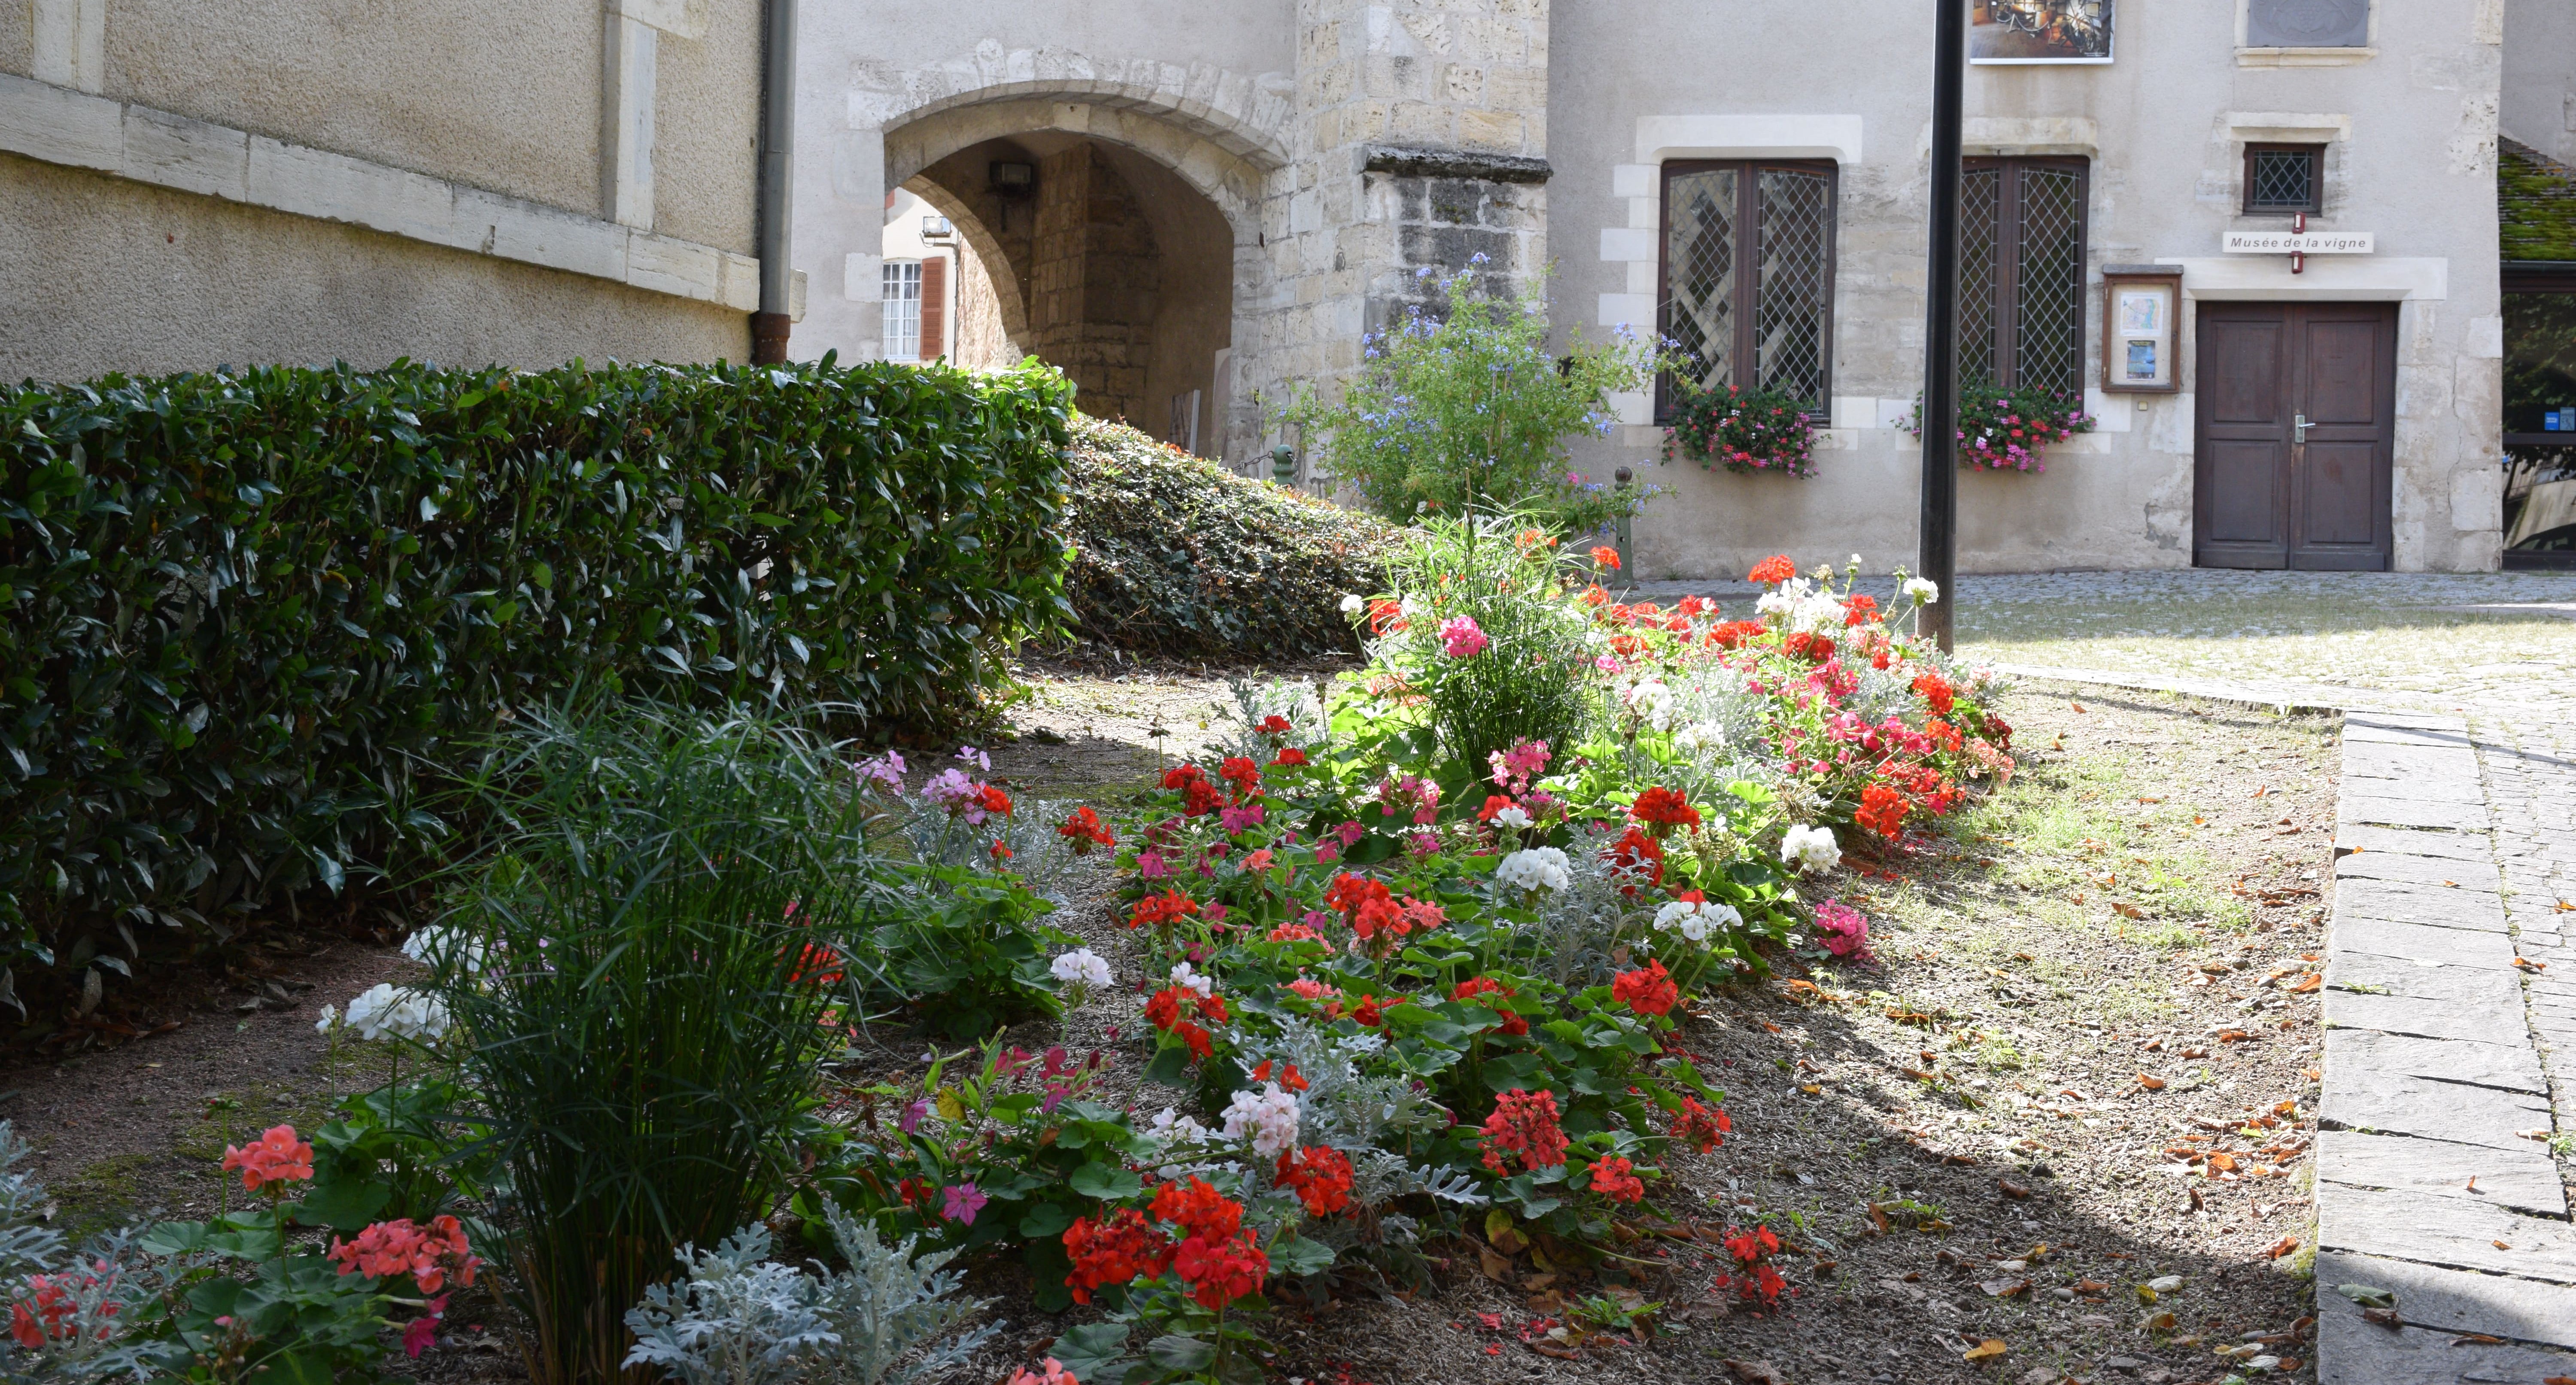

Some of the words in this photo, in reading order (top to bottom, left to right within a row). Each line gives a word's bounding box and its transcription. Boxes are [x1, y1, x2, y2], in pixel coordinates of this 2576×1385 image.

[2231, 238, 2278, 247] Musée
[2284, 238, 2300, 247] de
[2306, 238, 2318, 247] la
[2325, 238, 2366, 250] vigne
